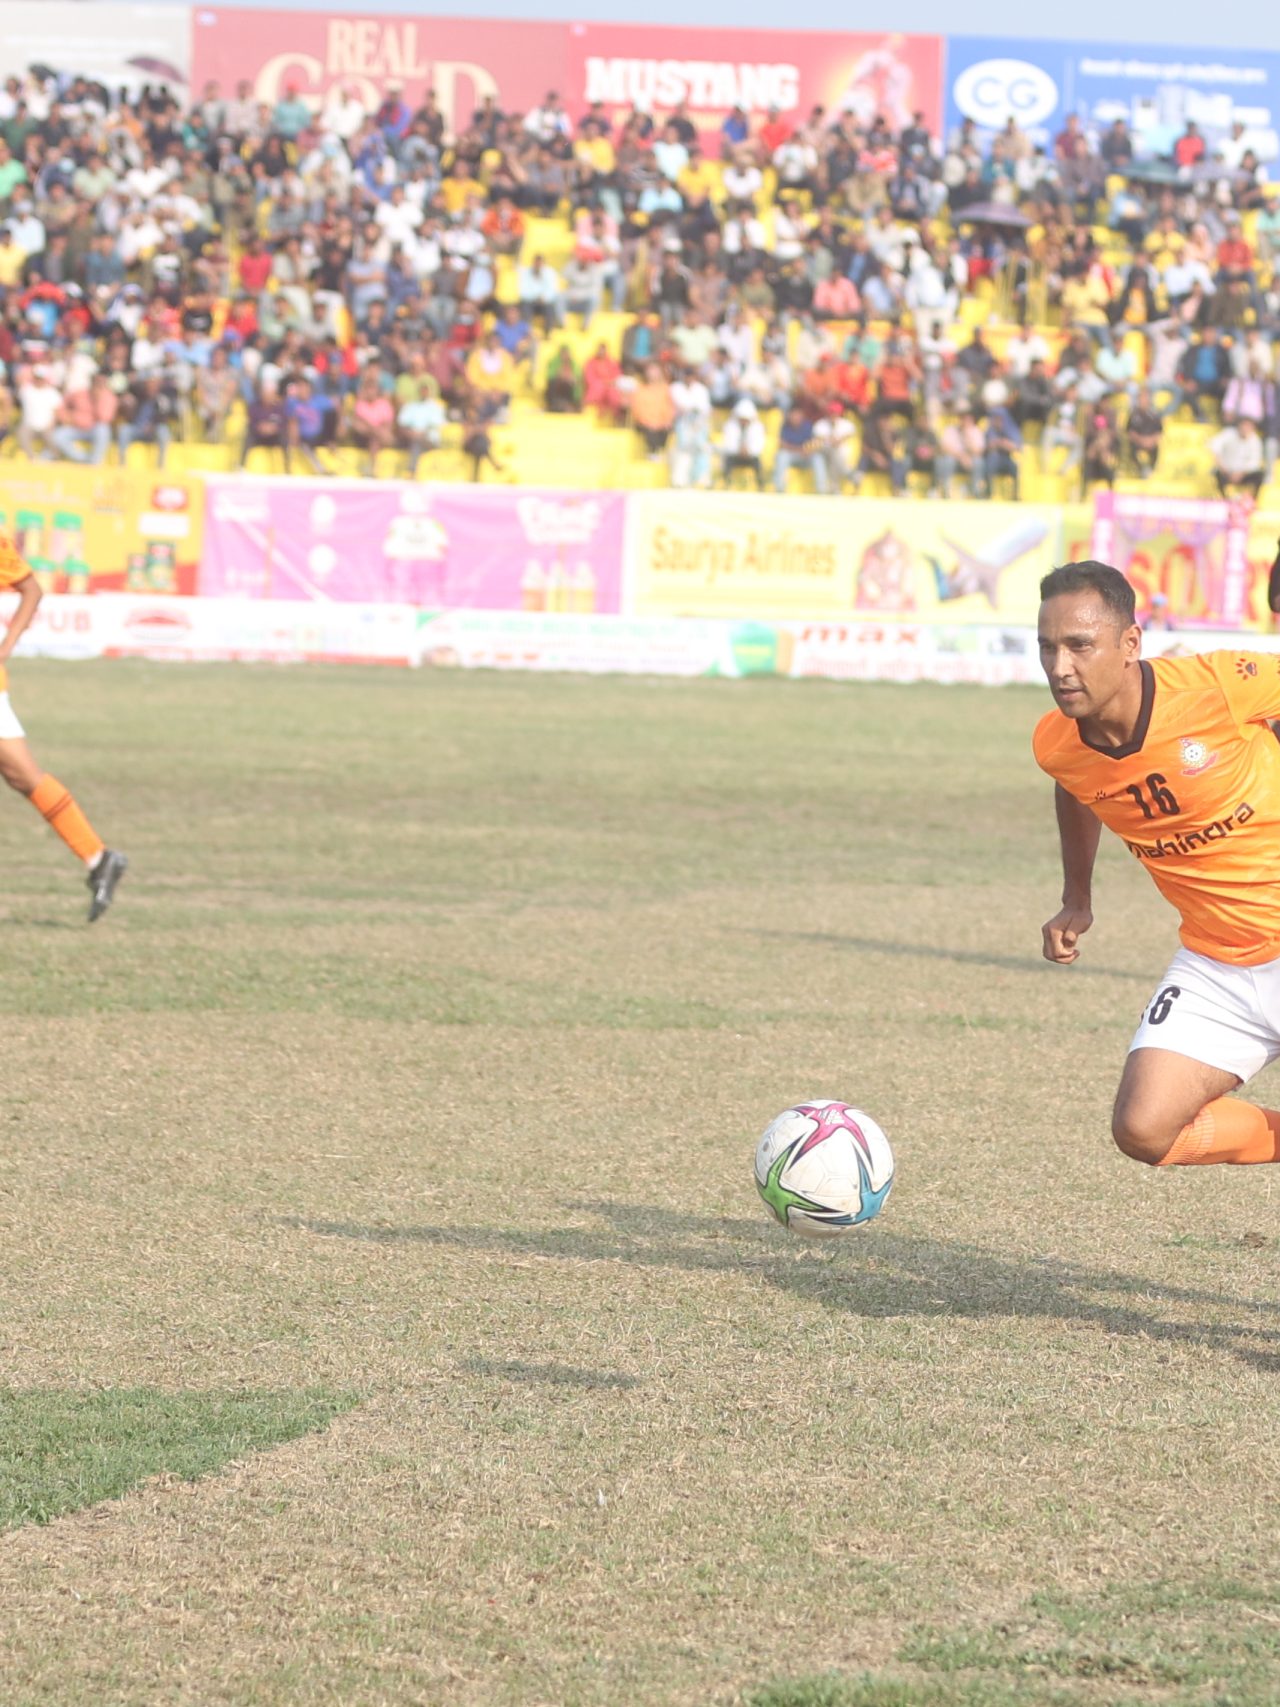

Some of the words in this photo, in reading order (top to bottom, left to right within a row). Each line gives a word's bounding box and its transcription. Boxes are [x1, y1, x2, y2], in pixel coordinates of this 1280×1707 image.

[326, 18, 428, 79] REAL
[252, 52, 501, 145] GOD
[585, 57, 800, 112] MUSTANG
[971, 75, 1039, 111] CG
[1126, 772, 1181, 820] 16
[1141, 986, 1181, 1026] 6
